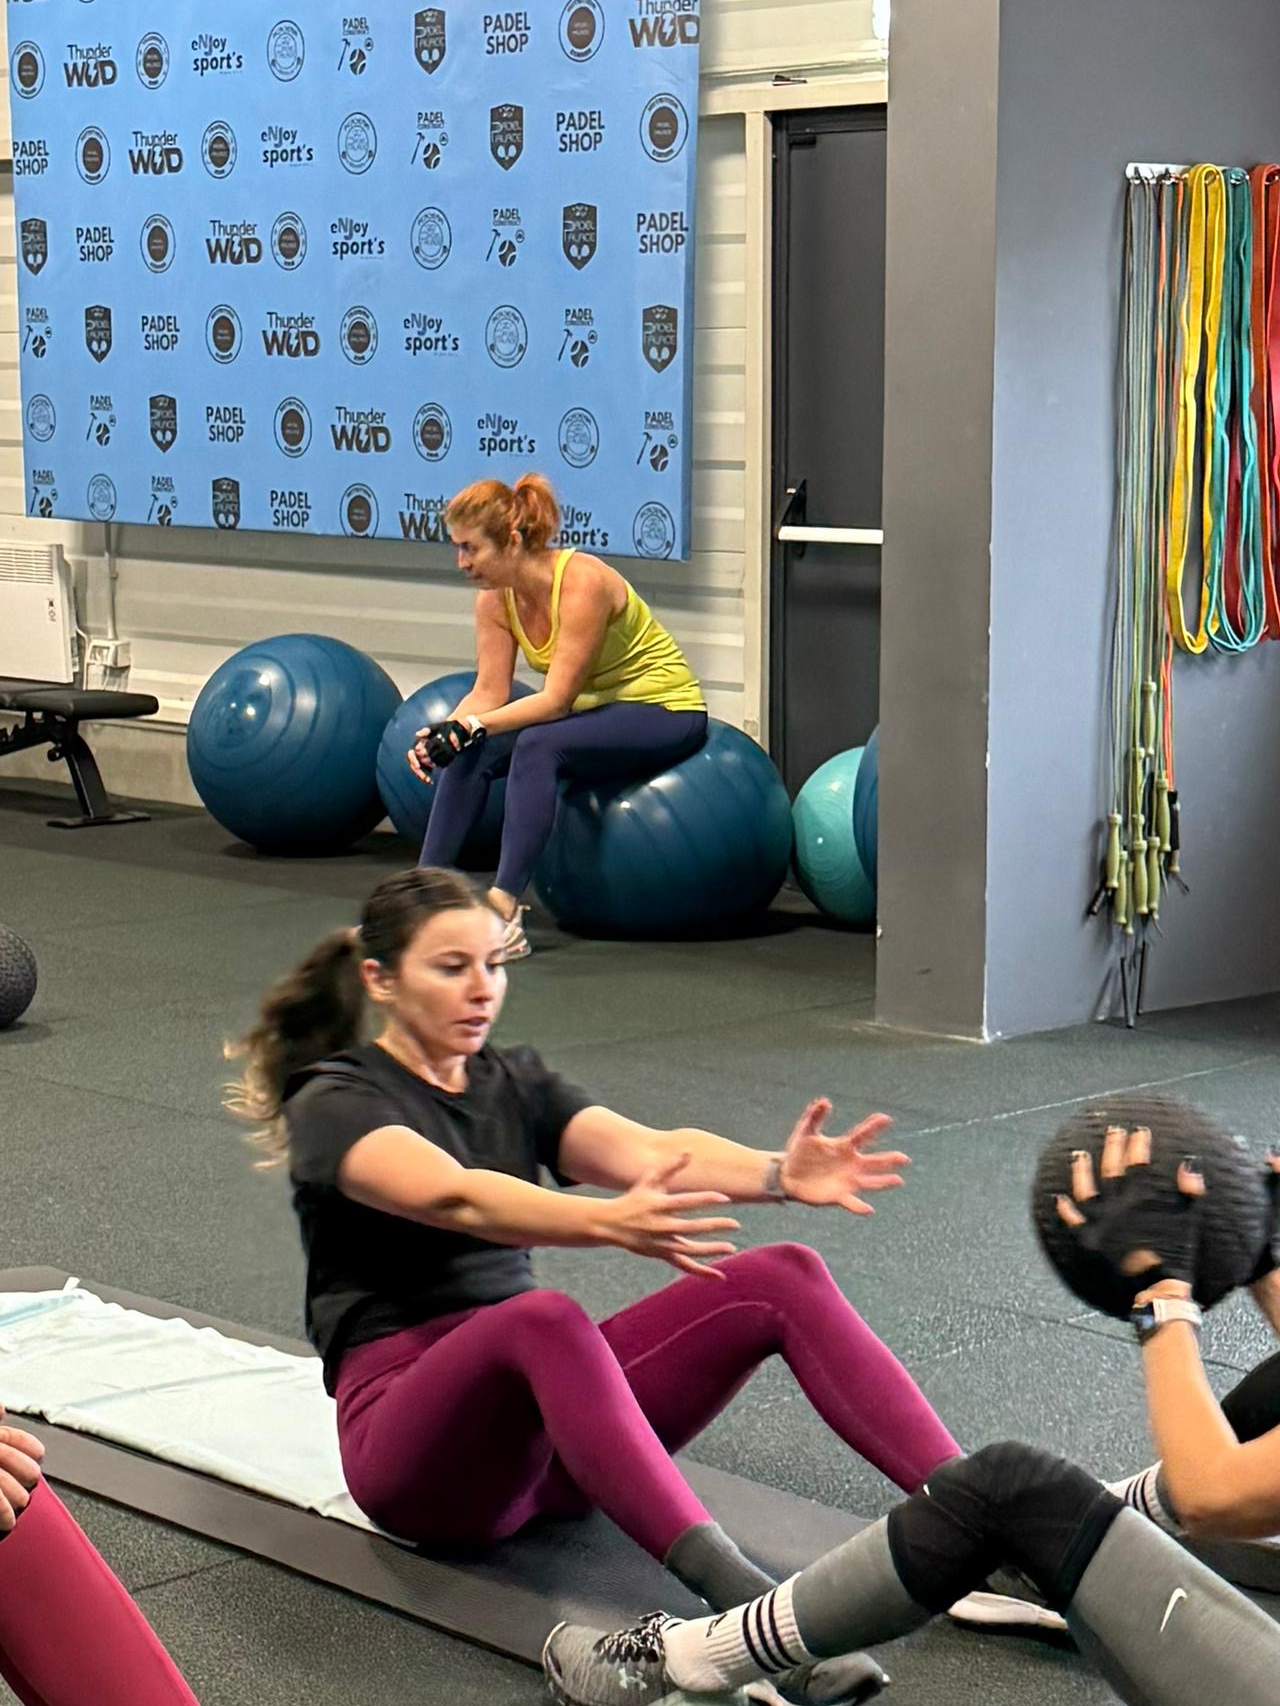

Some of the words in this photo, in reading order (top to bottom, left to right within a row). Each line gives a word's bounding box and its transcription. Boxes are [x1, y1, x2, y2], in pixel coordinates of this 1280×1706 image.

[343, 18, 368, 30] PADEL
[484, 12, 531, 33] PADEL
[486, 33, 528, 54] SHOP
[67, 43, 115, 64] Thunder
[193, 48, 242, 76] sport's
[417, 112, 444, 125] PADEL
[491, 121, 521, 132] PADEL
[557, 111, 605, 131] PADEL
[13, 140, 49, 157] PADEL
[132, 130, 181, 153] Thunder
[559, 132, 602, 152] SHOP
[263, 144, 313, 168] sport's
[16, 158, 48, 175] SHOP
[493, 209, 521, 222] PADEL
[637, 212, 689, 232] PADEL
[76, 227, 114, 243] PADEL
[210, 220, 259, 241] Thunder
[564, 221, 595, 231] PADEL
[333, 233, 384, 260] sport's
[639, 234, 685, 253] SHOP
[80, 245, 113, 261] SHOP
[267, 312, 315, 332] Thunder
[565, 309, 593, 320] PADEL
[142, 316, 180, 332] PADEL
[644, 323, 675, 333] PADEL
[144, 334, 178, 350] SHOP
[405, 334, 459, 356] sport's
[206, 406, 245, 424] PADEL
[335, 406, 386, 428] Thunder
[644, 412, 673, 425] PADEL
[209, 425, 243, 442] SHOP
[479, 435, 535, 456] sport's
[271, 490, 311, 509] PADEL
[273, 509, 309, 527] SHOP
